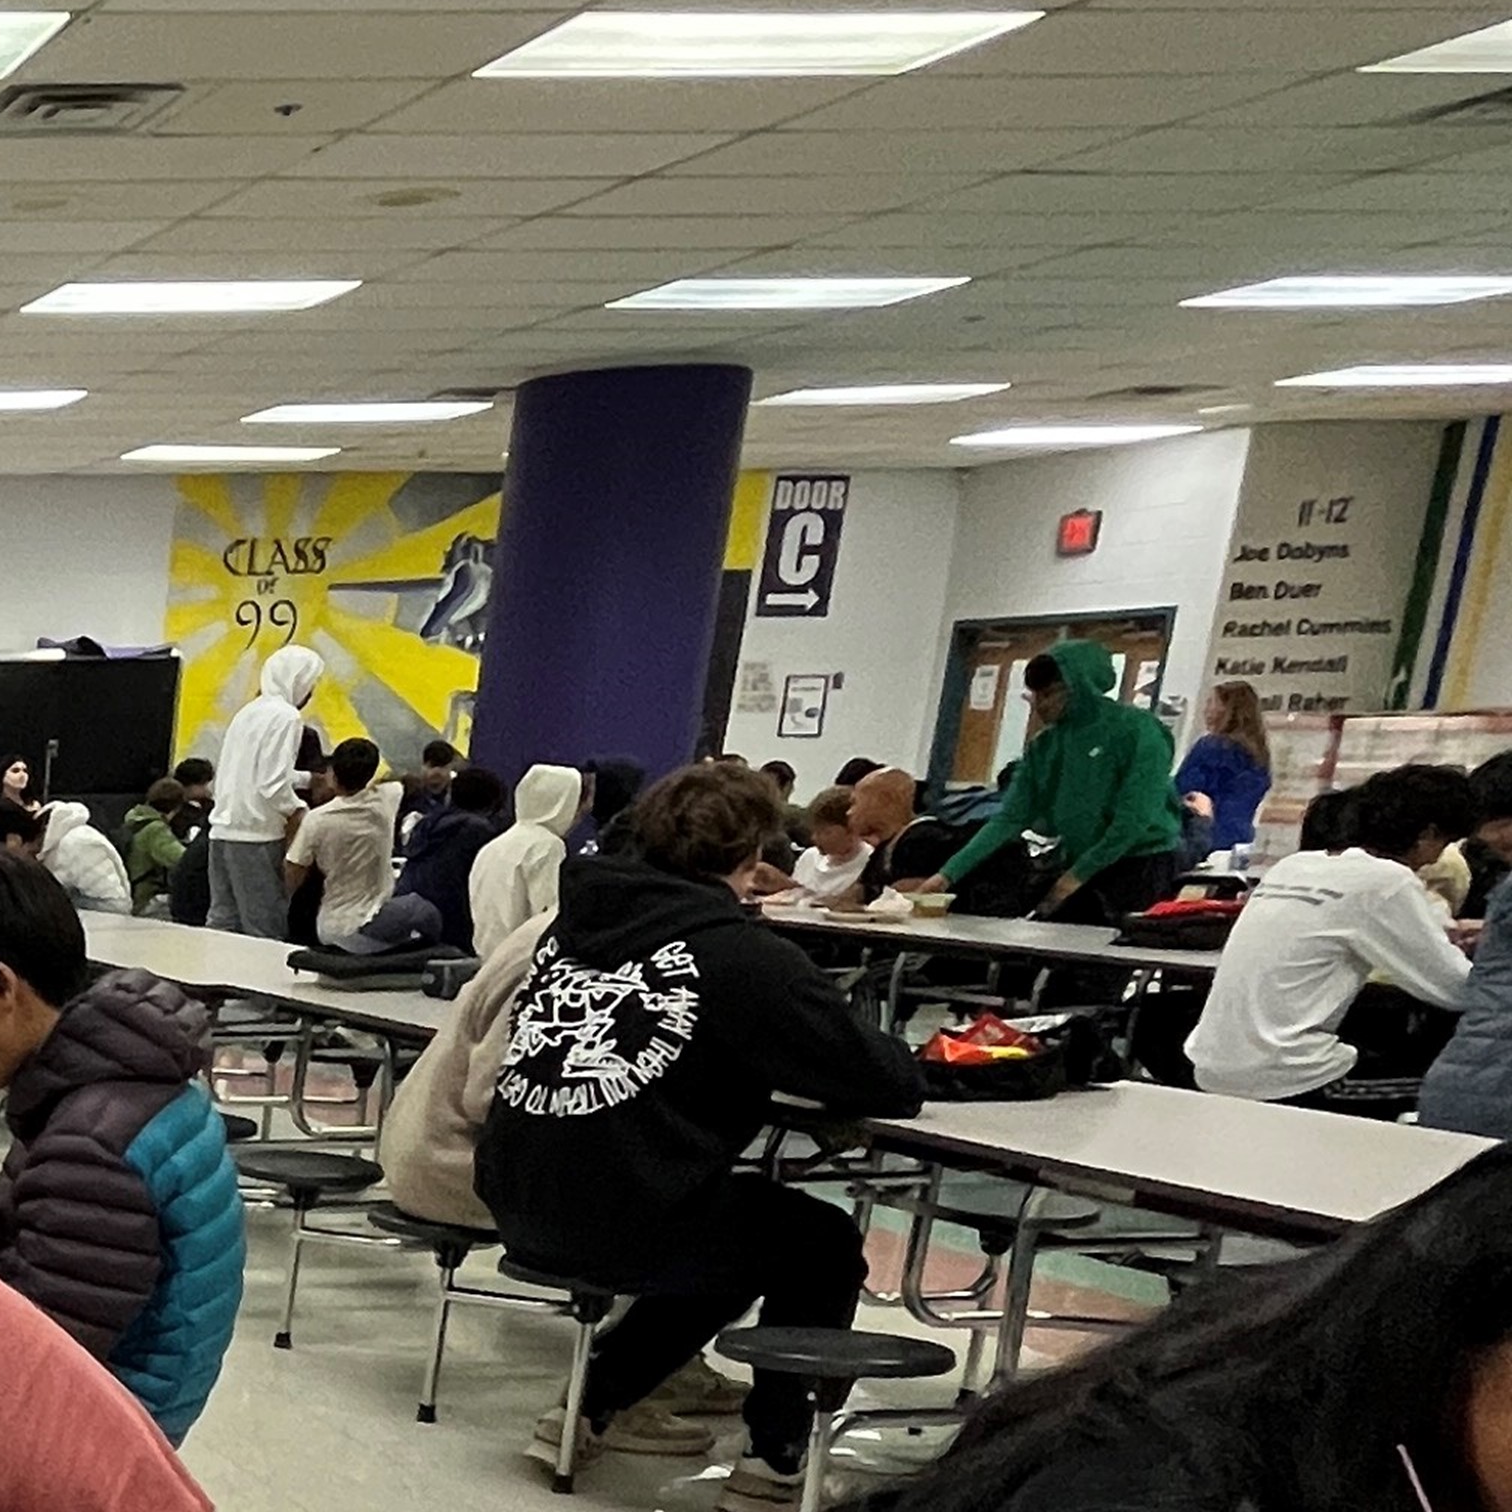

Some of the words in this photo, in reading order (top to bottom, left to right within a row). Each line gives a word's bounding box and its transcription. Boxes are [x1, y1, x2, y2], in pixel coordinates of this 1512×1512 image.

[775, 480, 846, 510] DOOR
[223, 536, 333, 577] CLASS
[778, 511, 825, 586] C
[1229, 582, 1269, 602] Ben
[235, 599, 297, 650] 99
[1222, 619, 1292, 638] Rachel
